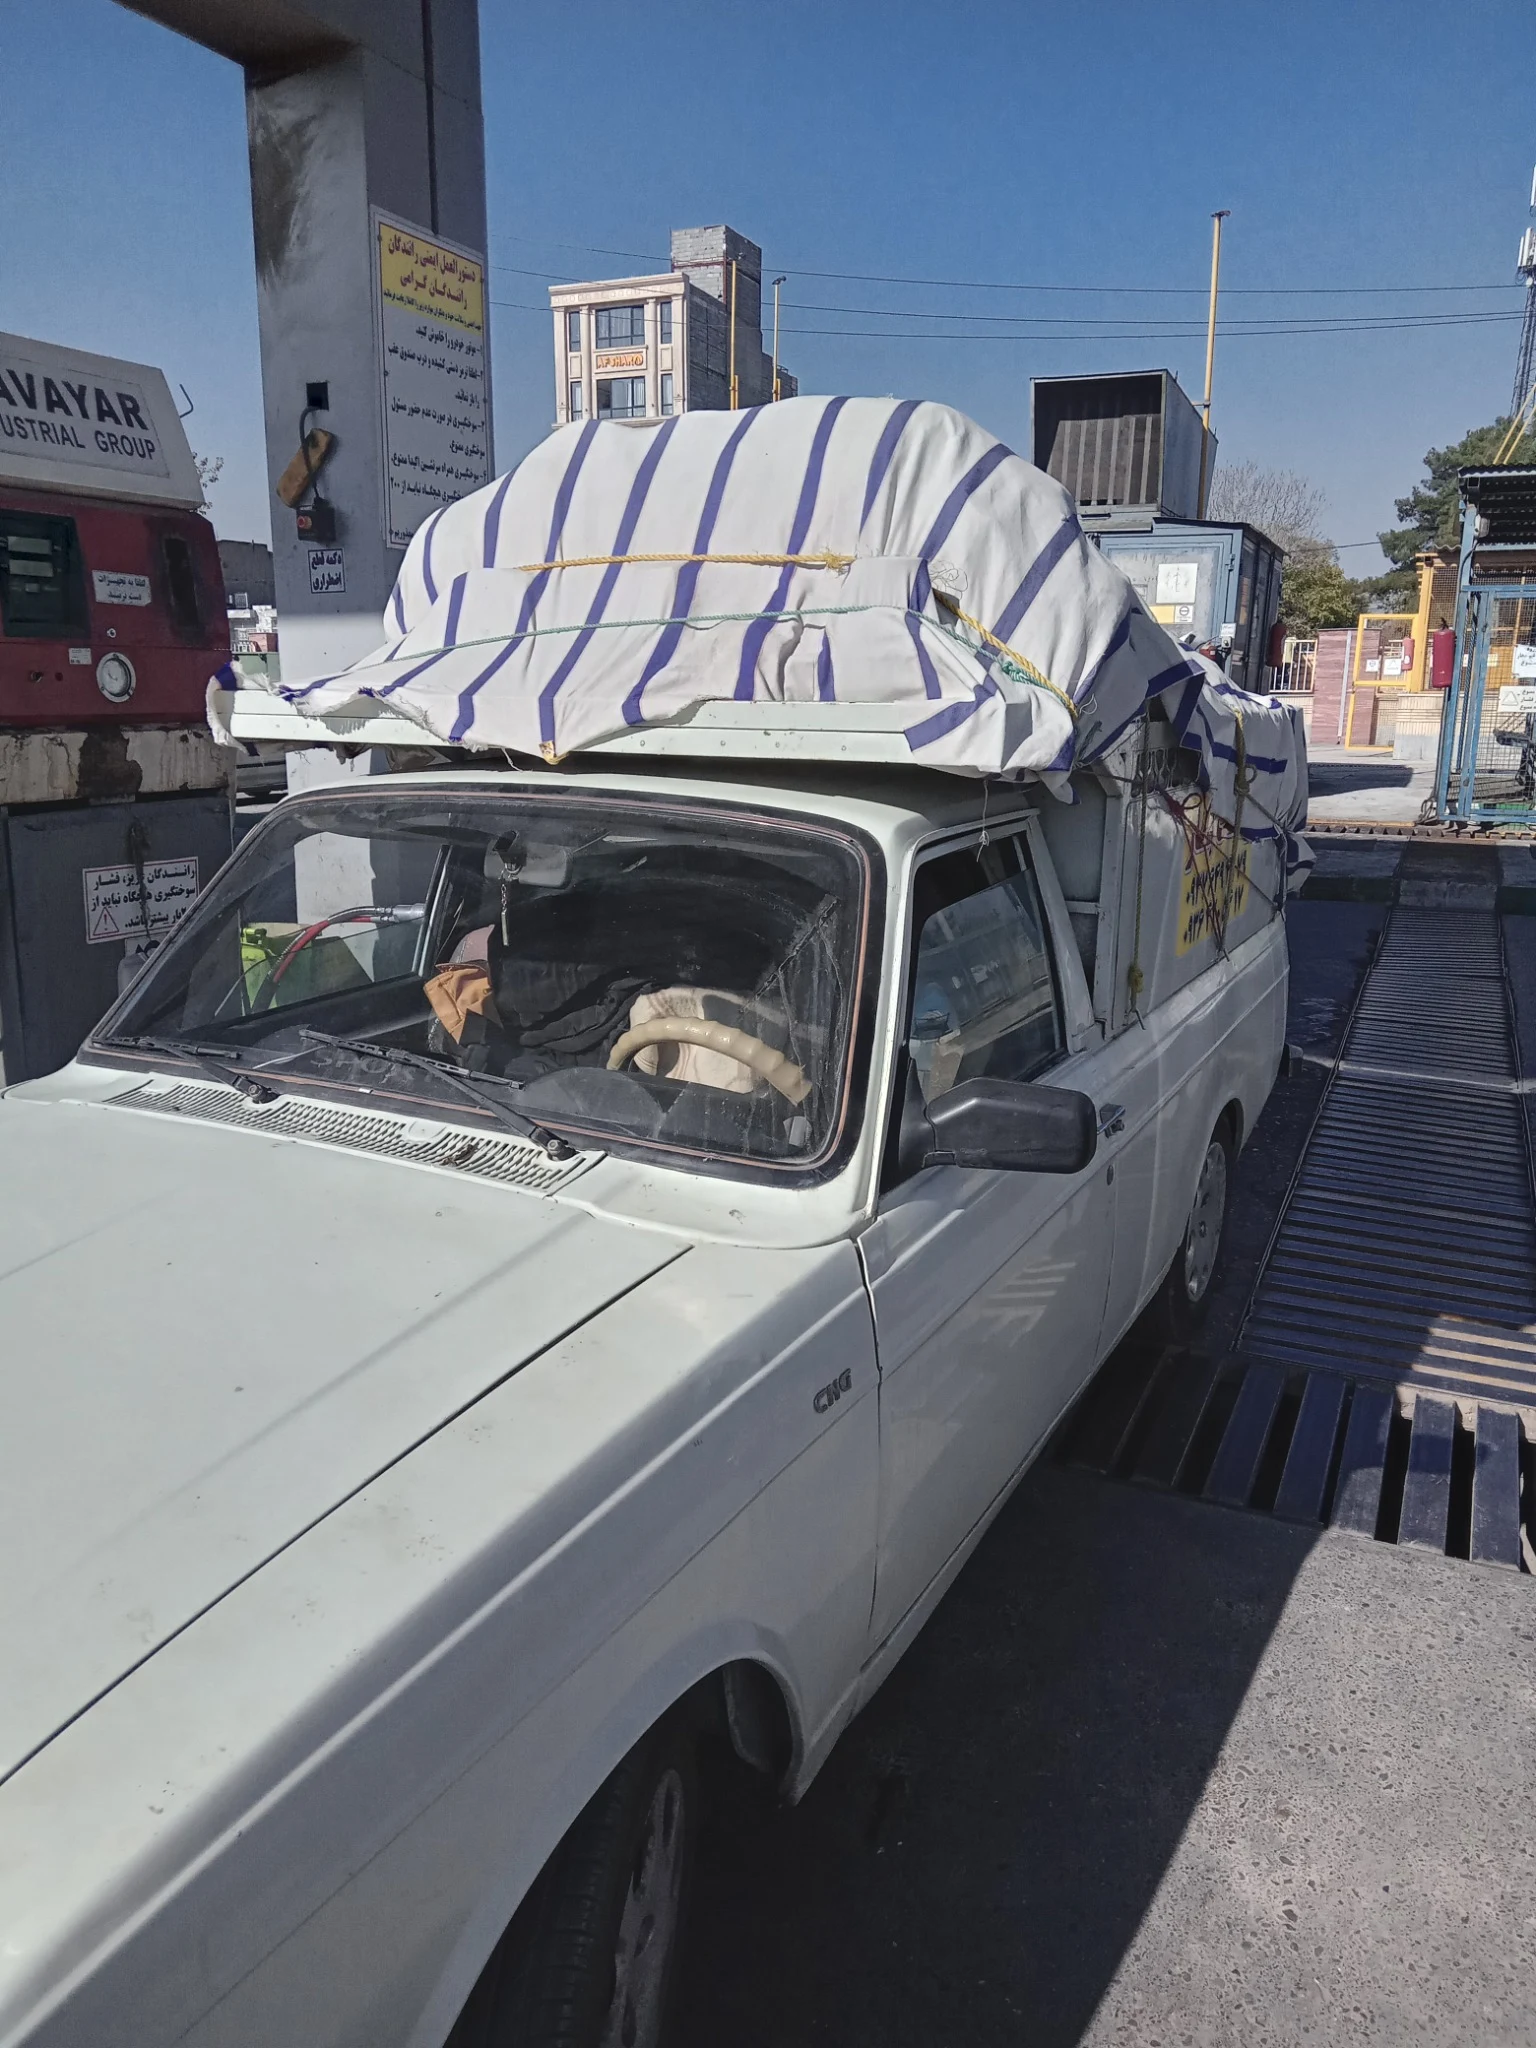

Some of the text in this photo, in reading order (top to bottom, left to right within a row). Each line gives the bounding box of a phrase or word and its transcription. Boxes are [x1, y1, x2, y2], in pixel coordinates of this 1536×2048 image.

[94, 430, 156, 460] GROUP
[312, 572, 342, 590] اضطراری
[93, 871, 120, 891] فشار
[147, 864, 195, 884] رانندگان
[101, 892, 121, 909] نباید
[154, 884, 196, 903] سوختگیری
[91, 895, 99, 912] از
[813, 1368, 852, 1413] CNG
